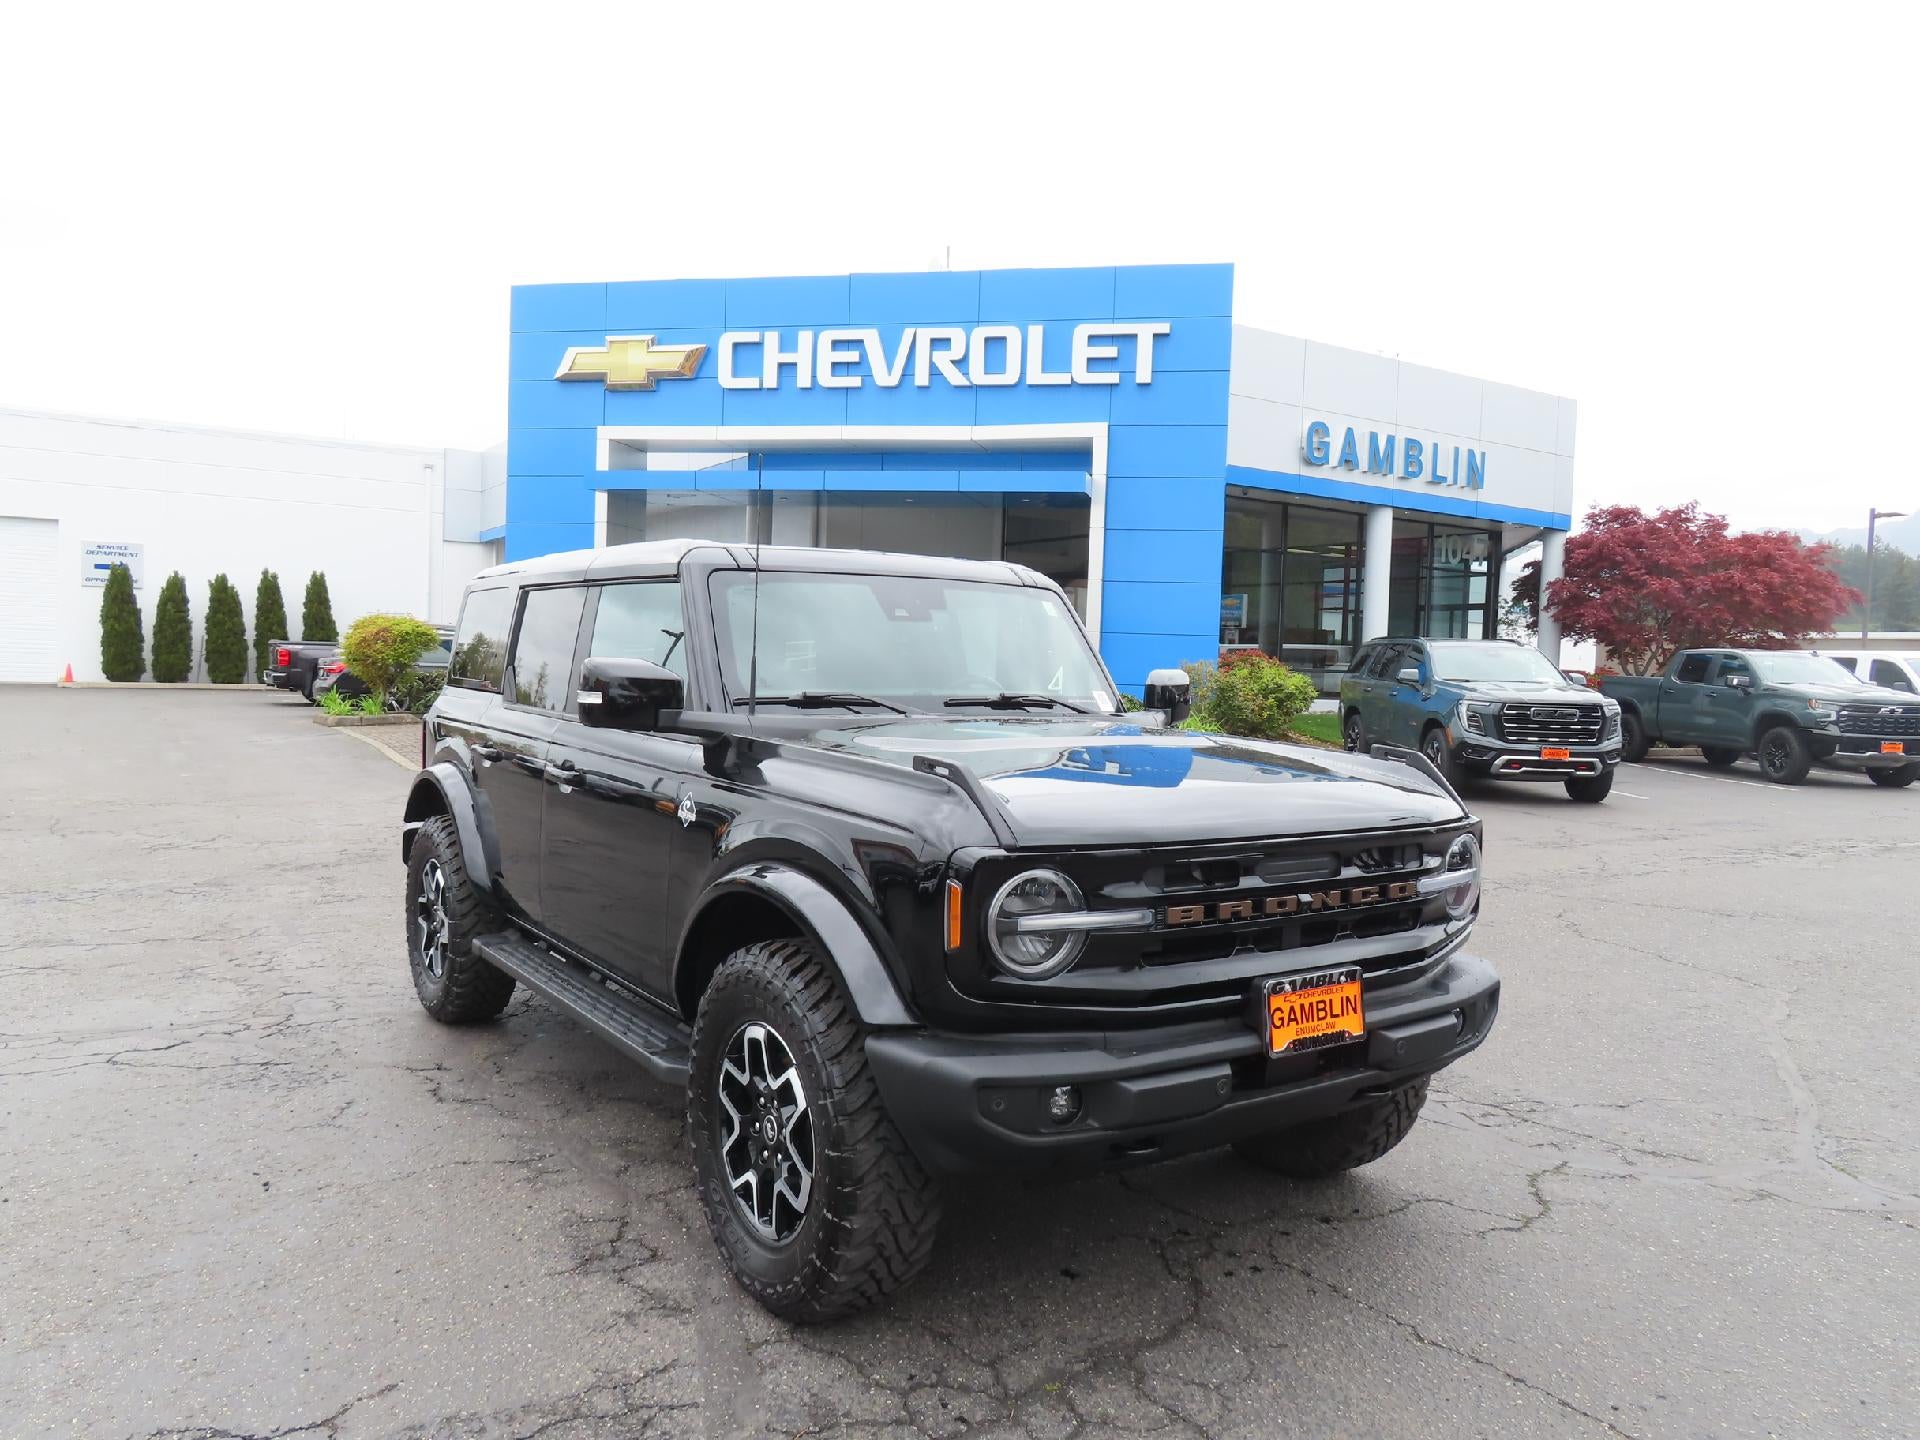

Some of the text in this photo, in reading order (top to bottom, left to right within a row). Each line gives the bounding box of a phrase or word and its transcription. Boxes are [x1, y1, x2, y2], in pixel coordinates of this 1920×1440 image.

[716, 322, 1171, 390] CHEVROLET
[1303, 420, 1487, 491] GAMBLIN
[1167, 881, 1417, 926] BRONCO
[1271, 994, 1358, 1030] GAMBLIN
[1295, 1020, 1337, 1036] ENUMCLAW
